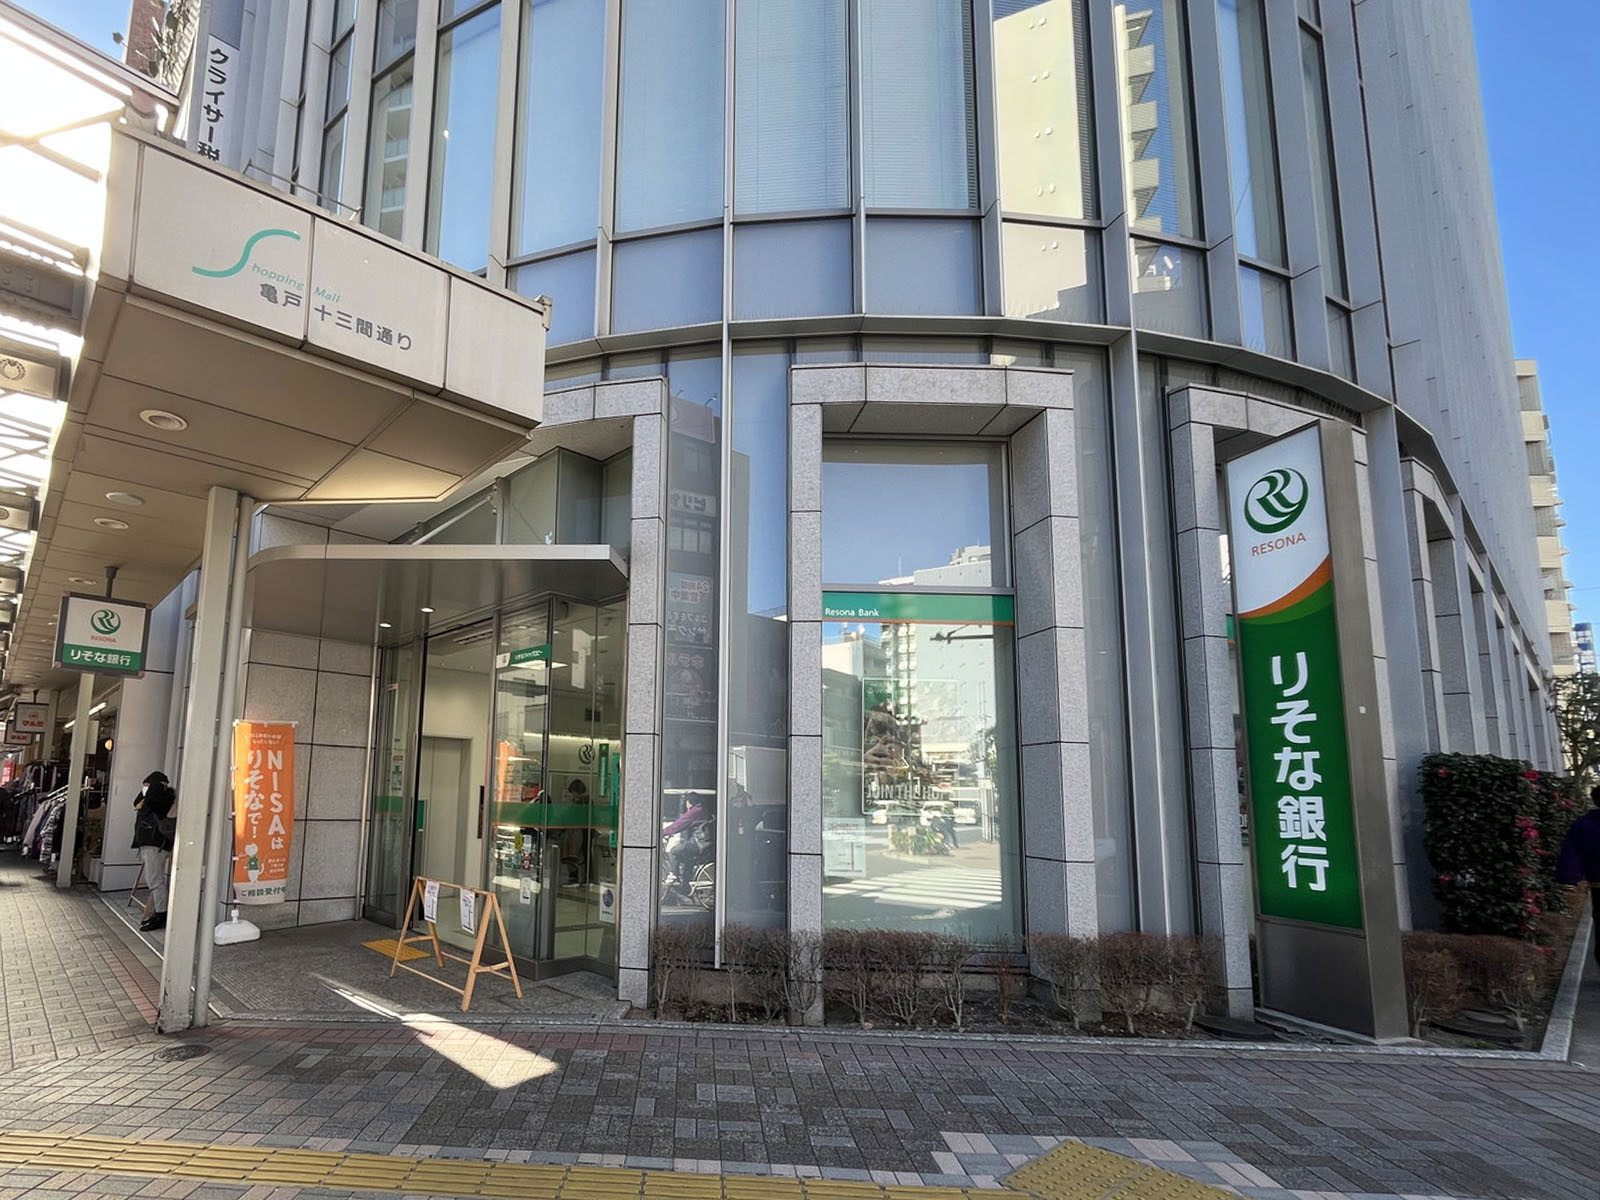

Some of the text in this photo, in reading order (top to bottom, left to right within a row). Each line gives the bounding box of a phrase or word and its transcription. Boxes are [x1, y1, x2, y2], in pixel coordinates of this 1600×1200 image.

[314, 286, 341, 303] Mall
[1251, 532, 1307, 557] RESONA
[825, 608, 879, 617] Resona Bank
[70, 649, 131, 666] りそな銀行
[1270, 651, 1330, 891] りそな銀行
